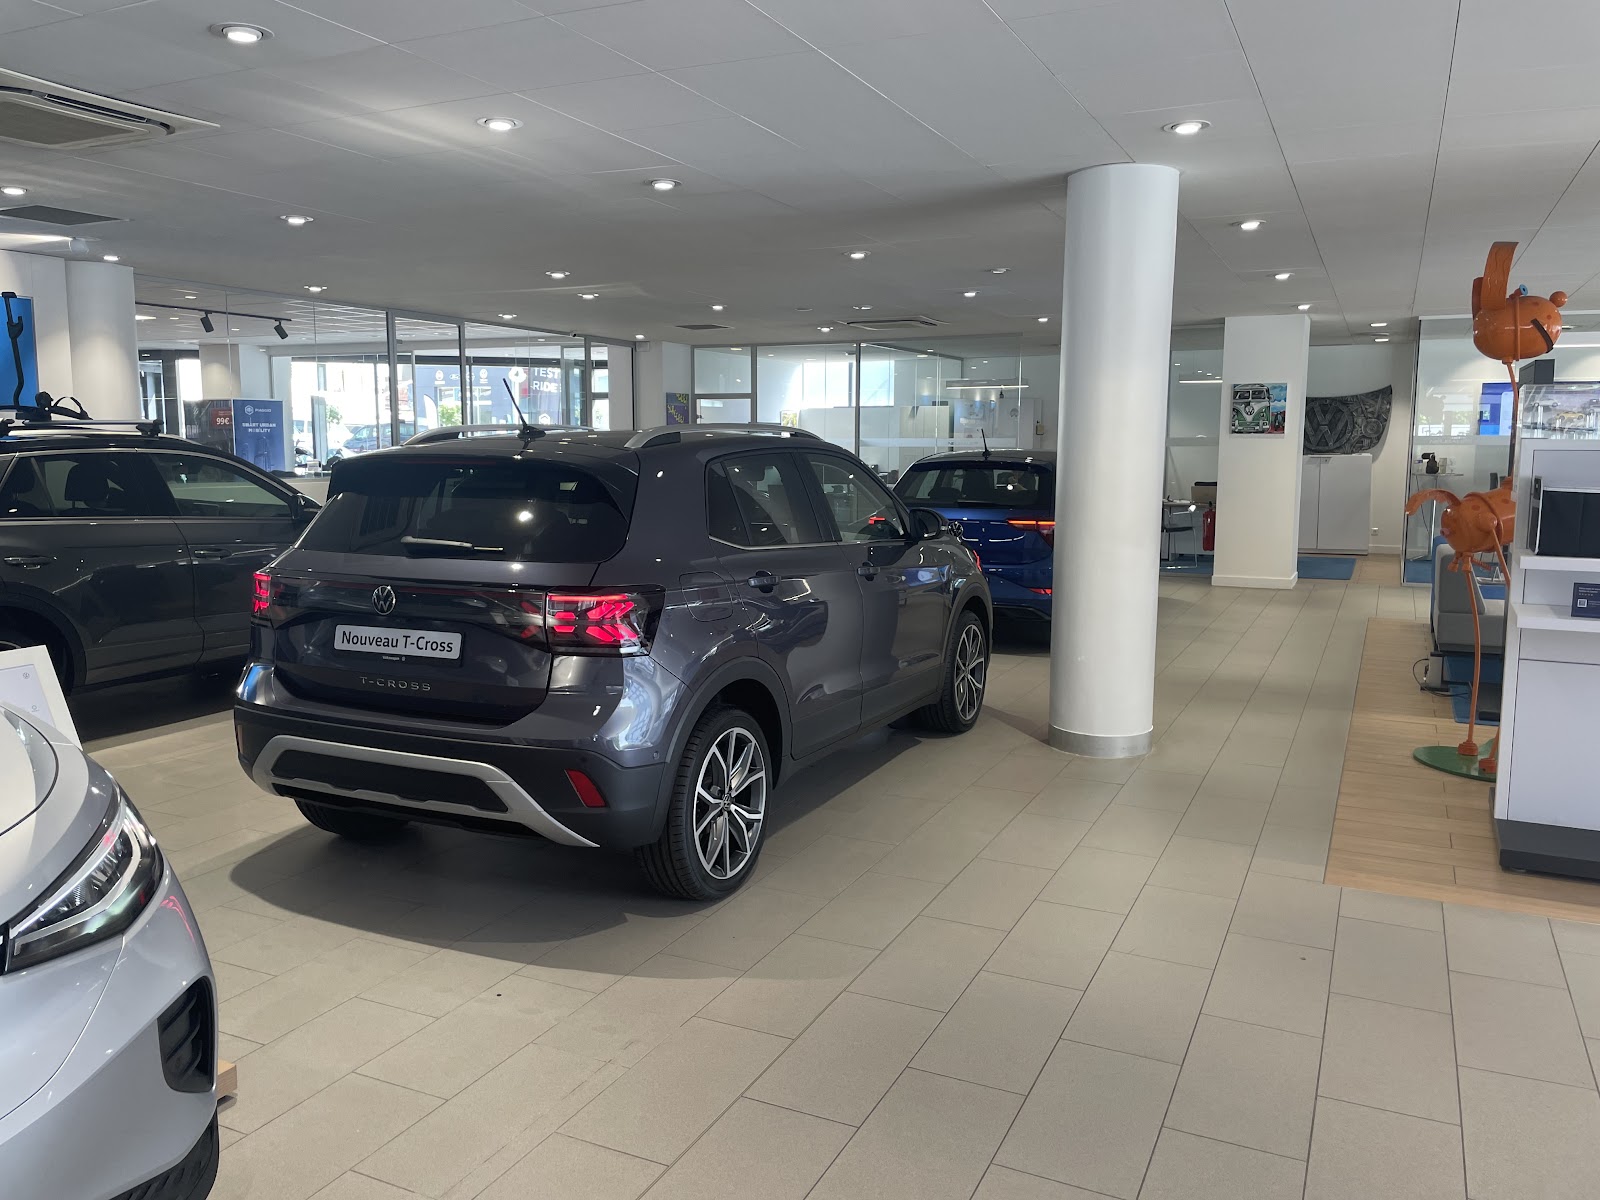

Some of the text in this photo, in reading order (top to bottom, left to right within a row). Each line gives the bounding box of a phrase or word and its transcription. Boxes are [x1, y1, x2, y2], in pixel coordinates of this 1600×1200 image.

[534, 367, 561, 384] TEST
[533, 381, 558, 393] RIDE
[216, 417, 230, 425] 99€
[341, 630, 453, 653] Nouveau T-Cross
[359, 676, 431, 692] T-CROSS
